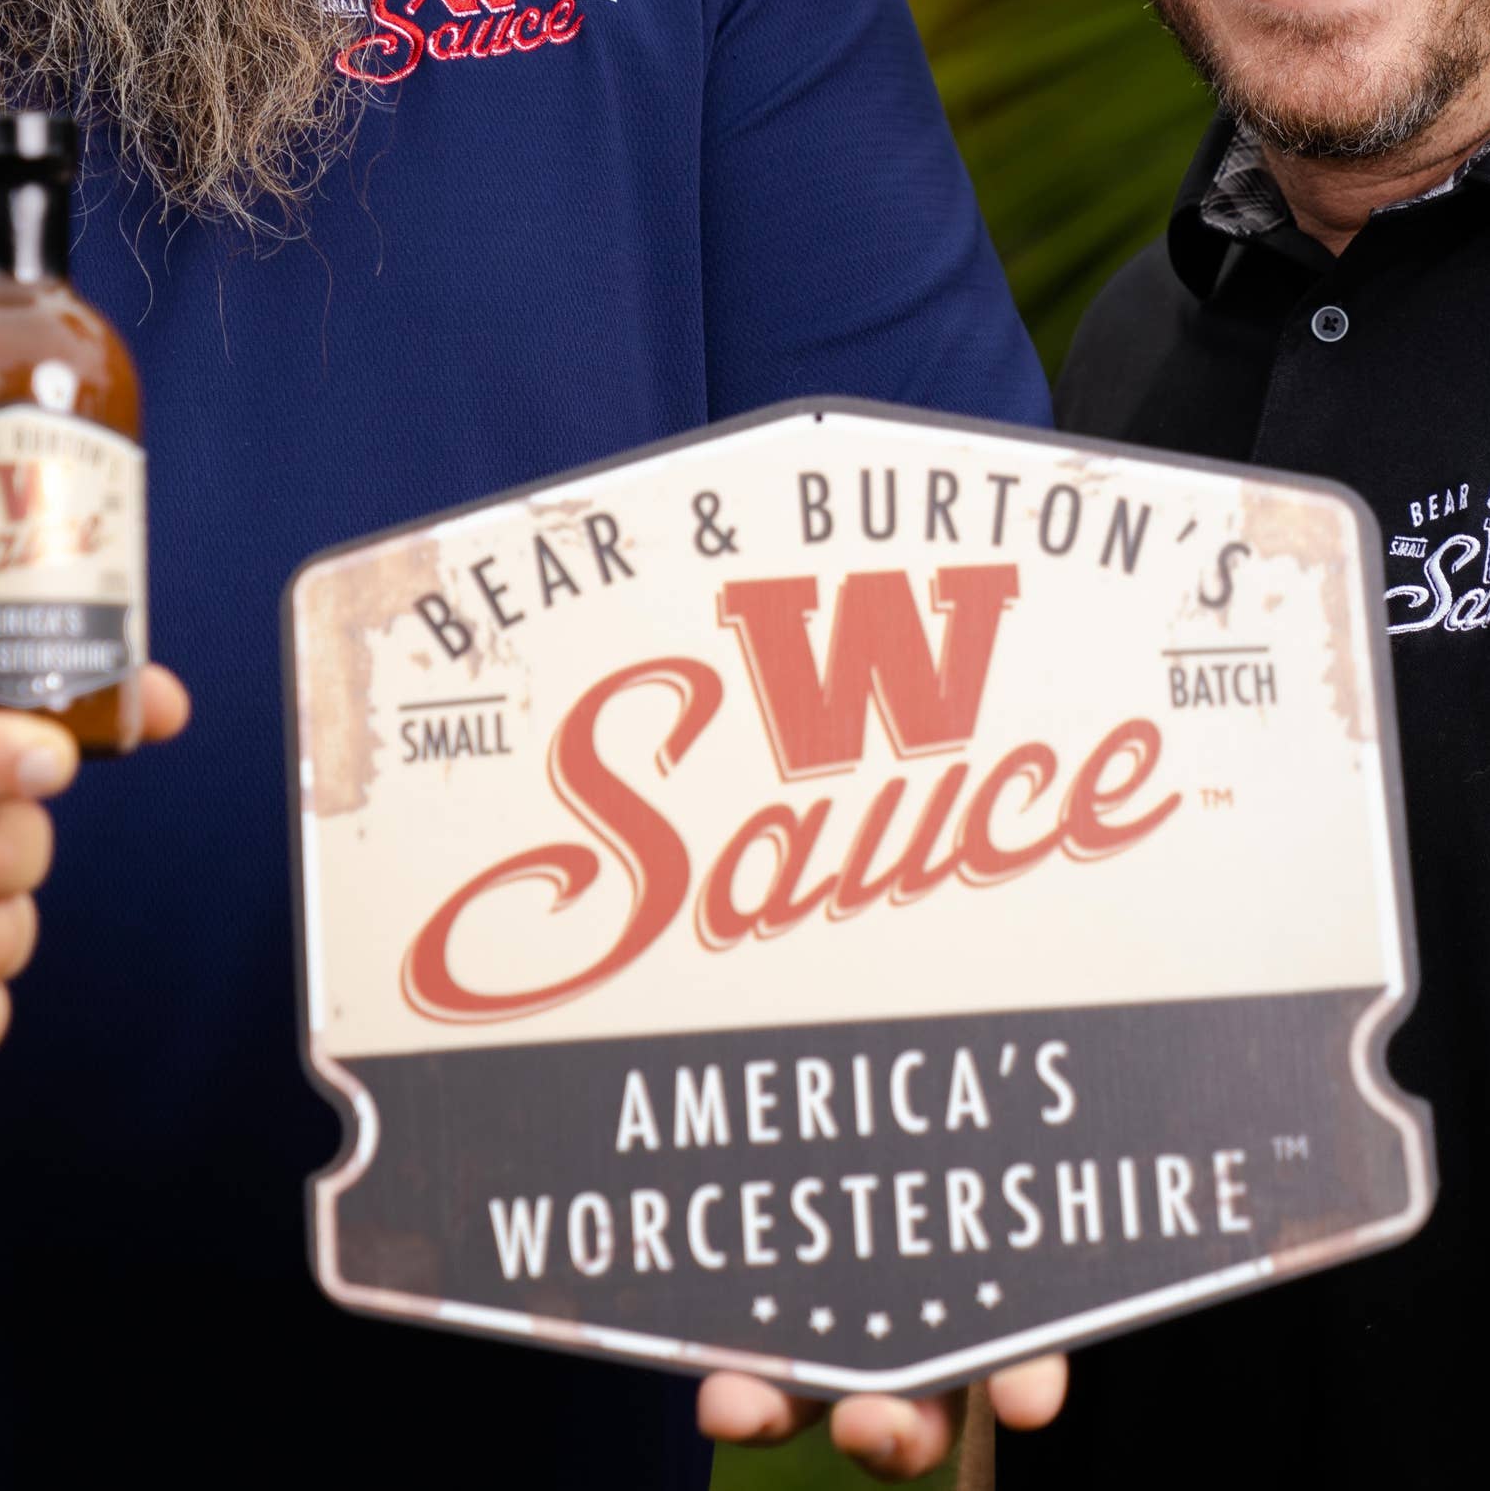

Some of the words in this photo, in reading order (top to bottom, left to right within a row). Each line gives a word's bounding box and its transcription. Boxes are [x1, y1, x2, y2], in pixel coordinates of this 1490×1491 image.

[1389, 539, 1427, 559] SMALL
[1410, 483, 1470, 528] BEAR
[414, 508, 635, 663] BEAR
[691, 489, 740, 557] &
[798, 467, 1254, 612] BURTON'S
[716, 562, 1022, 785] W
[1166, 660, 1279, 710] BATCH
[399, 712, 514, 765] SMALL
[399, 653, 1184, 1028] Sauce
[615, 1038, 1078, 1155] AMERICA'S
[486, 1147, 1254, 1283] WORCESTERSHIRE
